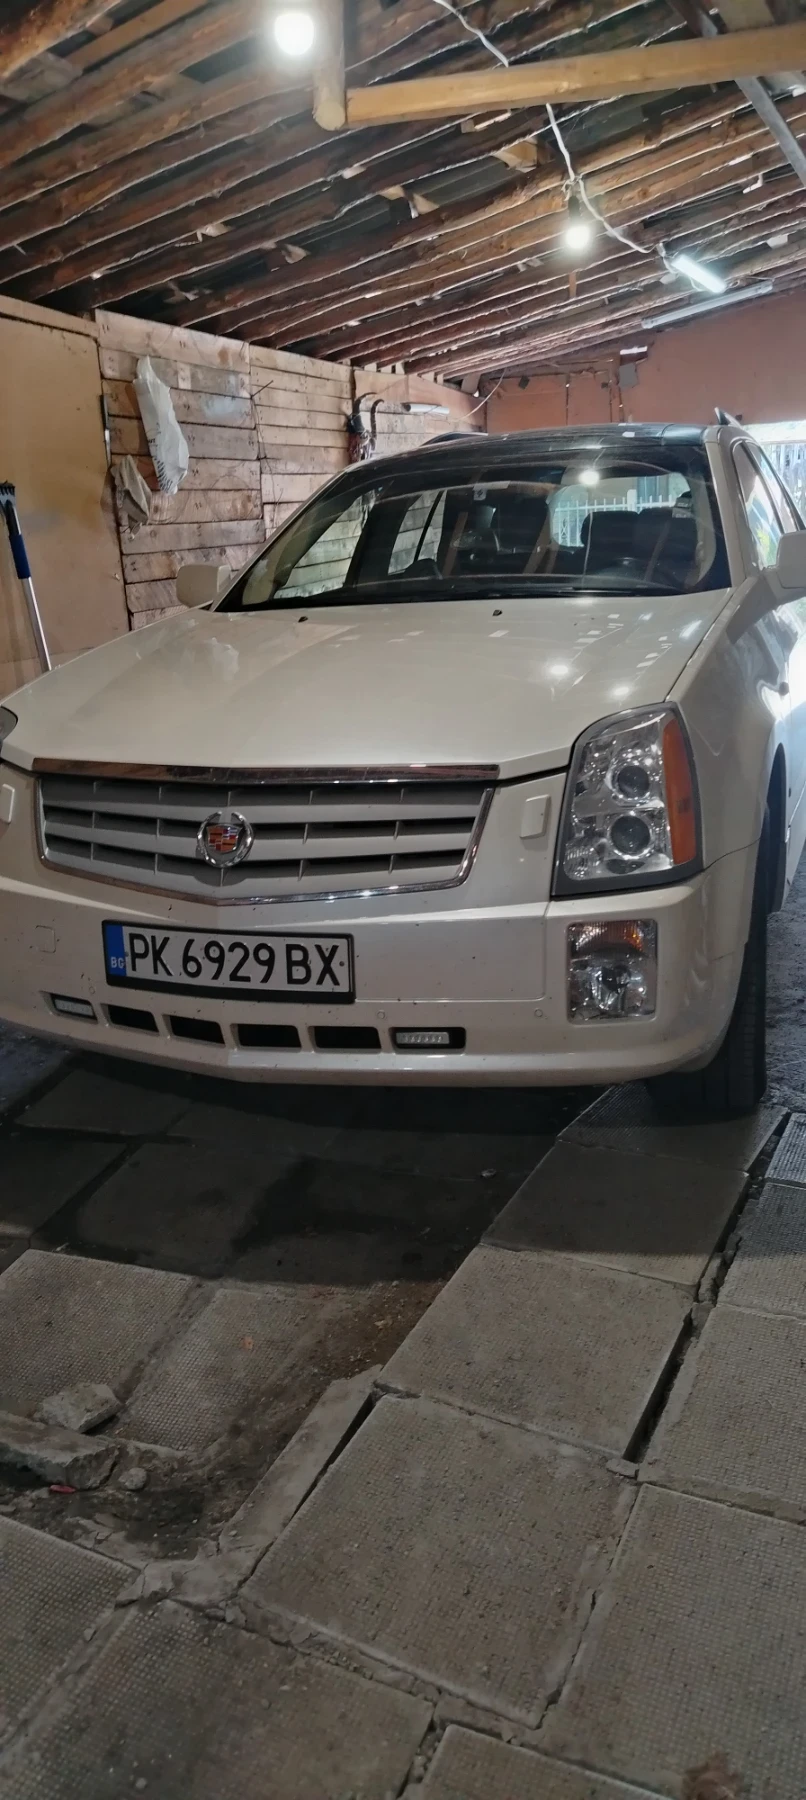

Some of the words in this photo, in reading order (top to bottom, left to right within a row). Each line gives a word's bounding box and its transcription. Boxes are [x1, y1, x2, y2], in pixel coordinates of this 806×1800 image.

[110, 956, 125, 969] BG
[128, 933, 173, 977] PK
[182, 939, 276, 984] 6929
[285, 943, 340, 986] BX
